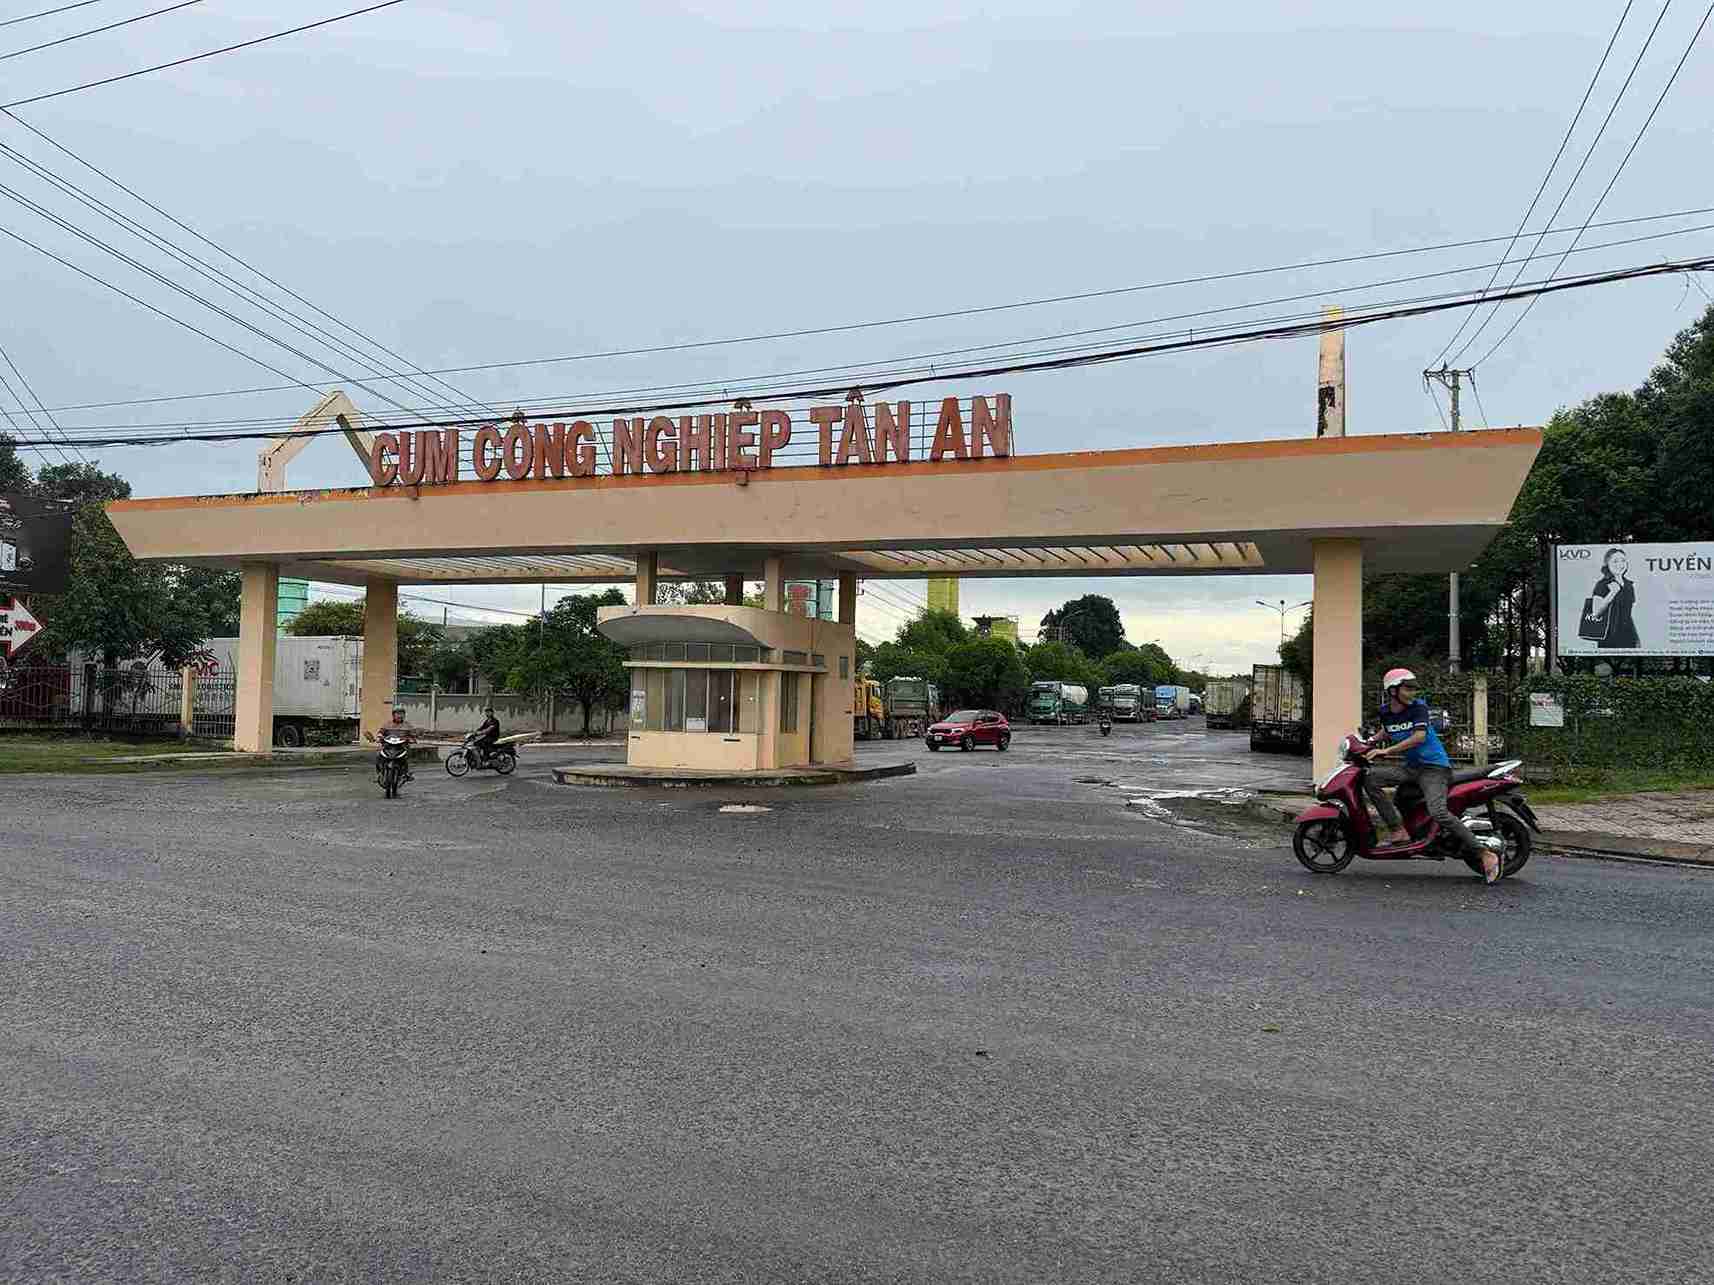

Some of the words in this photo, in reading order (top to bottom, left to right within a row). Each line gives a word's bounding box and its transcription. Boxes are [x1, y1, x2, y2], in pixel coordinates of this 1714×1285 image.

[473, 411, 597, 482] CÔNG
[810, 387, 911, 466] TÂN
[929, 393, 1010, 463] AN
